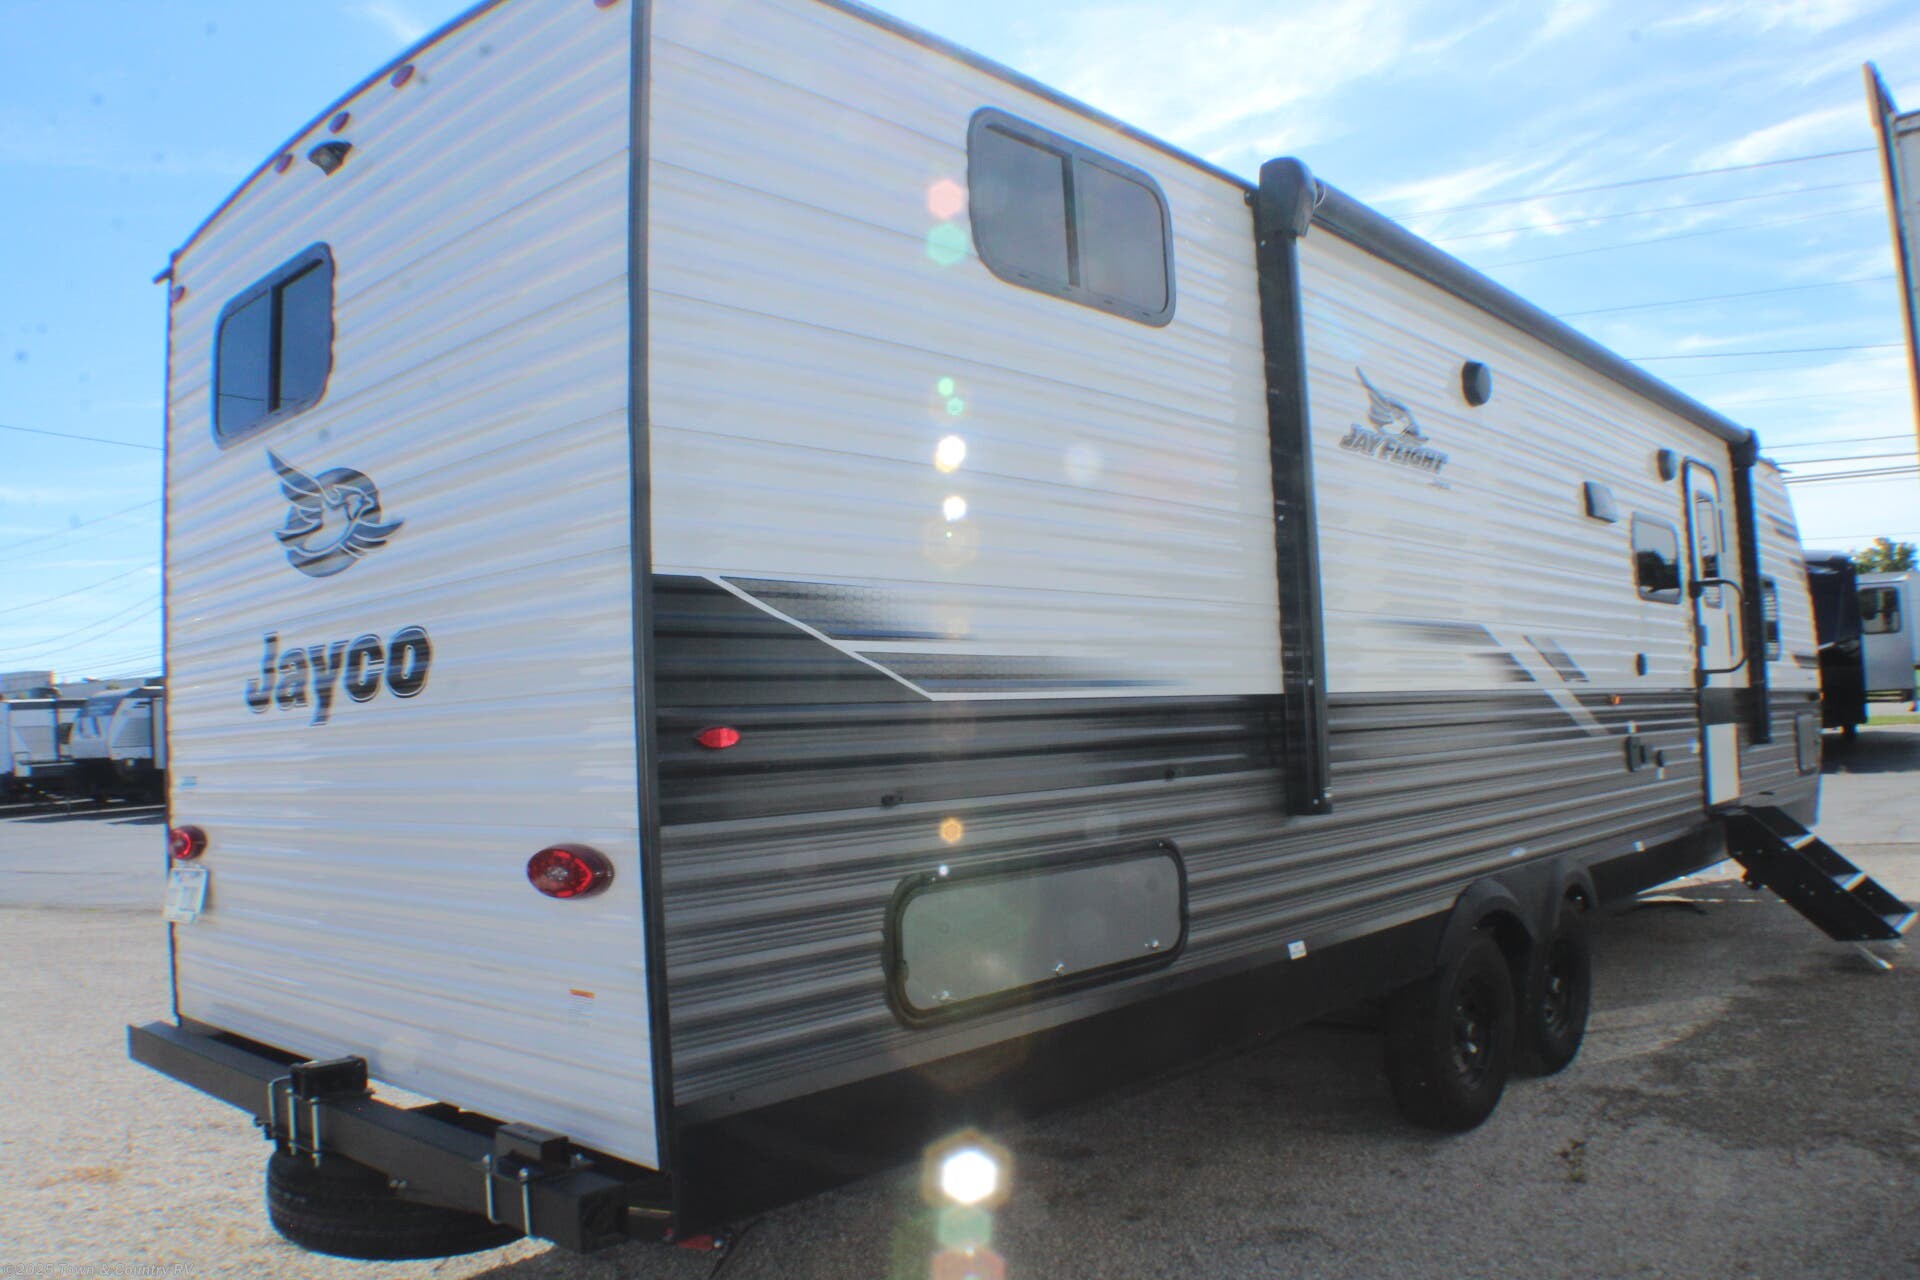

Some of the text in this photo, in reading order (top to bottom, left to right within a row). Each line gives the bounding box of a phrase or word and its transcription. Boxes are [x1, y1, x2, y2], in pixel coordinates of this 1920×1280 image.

[1340, 423, 1448, 474] JAY FLIGHT
[245, 625, 432, 727] Jayco
